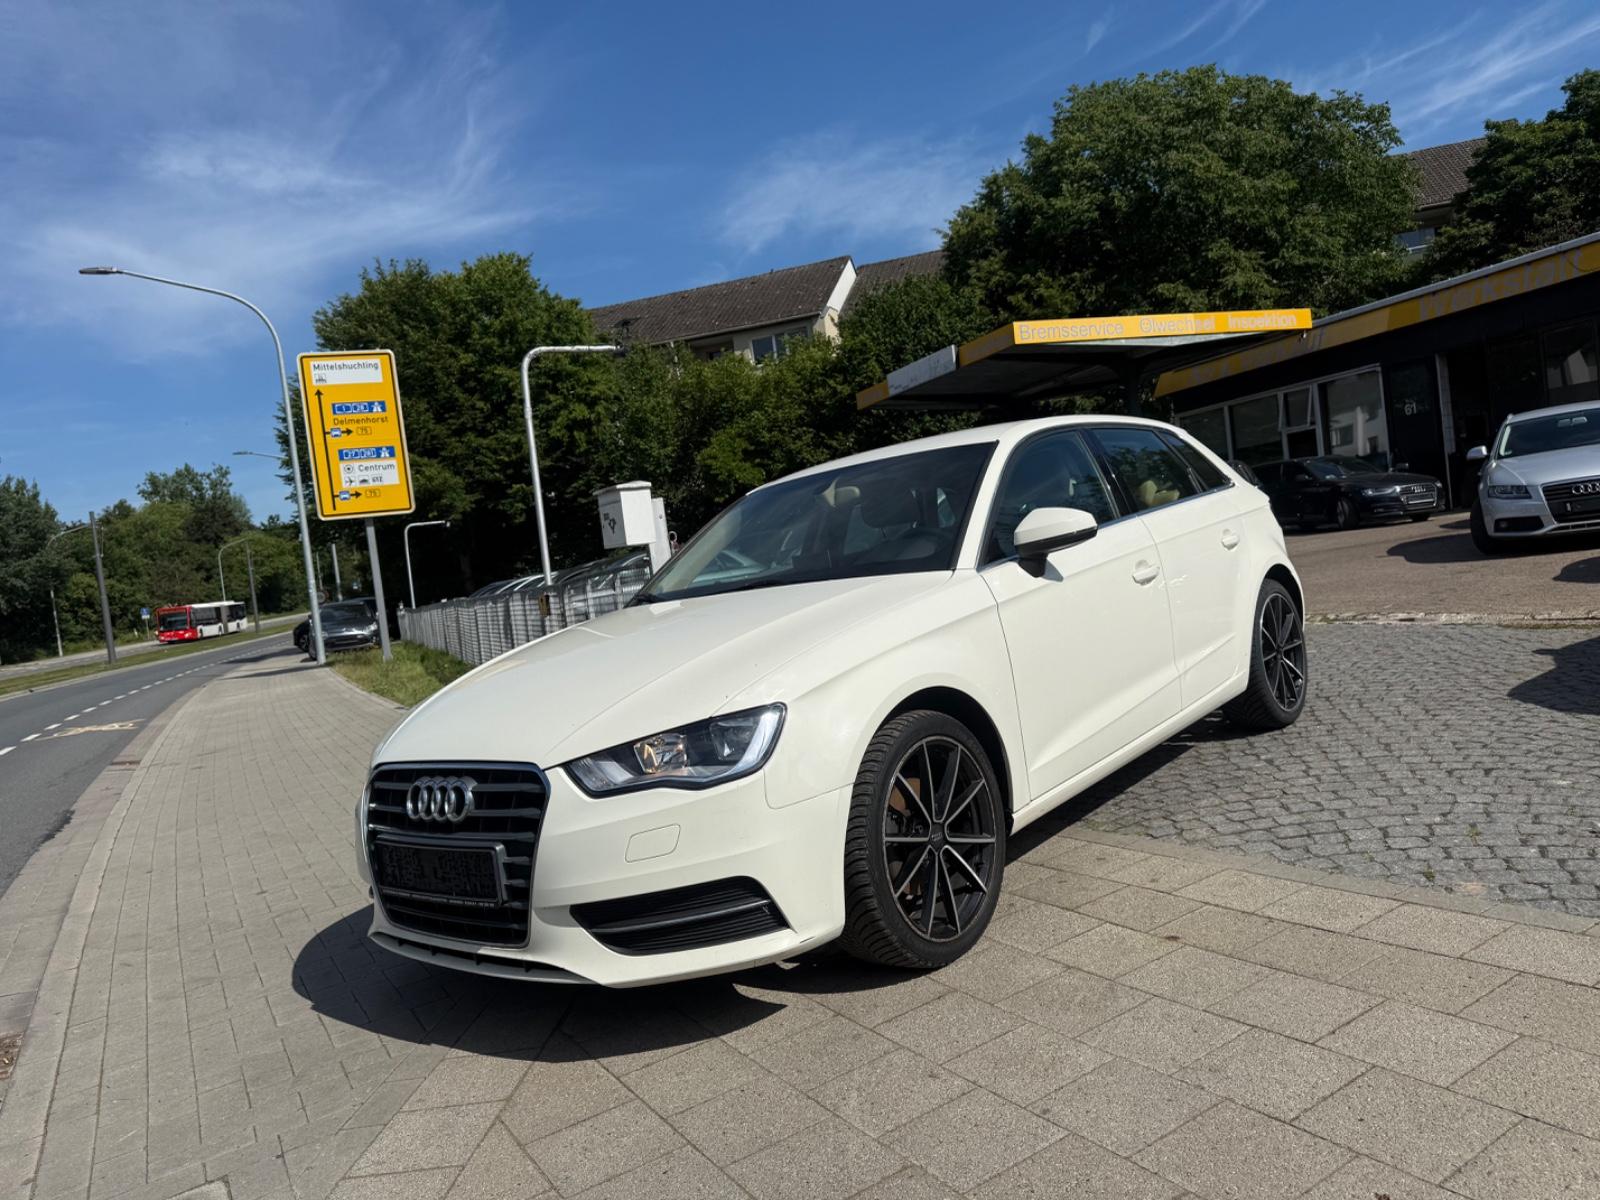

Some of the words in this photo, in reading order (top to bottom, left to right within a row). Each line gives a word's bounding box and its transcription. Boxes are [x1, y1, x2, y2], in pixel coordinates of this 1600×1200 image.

[1019, 320, 1124, 341] Bremsservice
[313, 361, 379, 372] Mittelshuchting
[333, 415, 389, 426] Delmenhorst
[358, 464, 395, 472] Centrum
